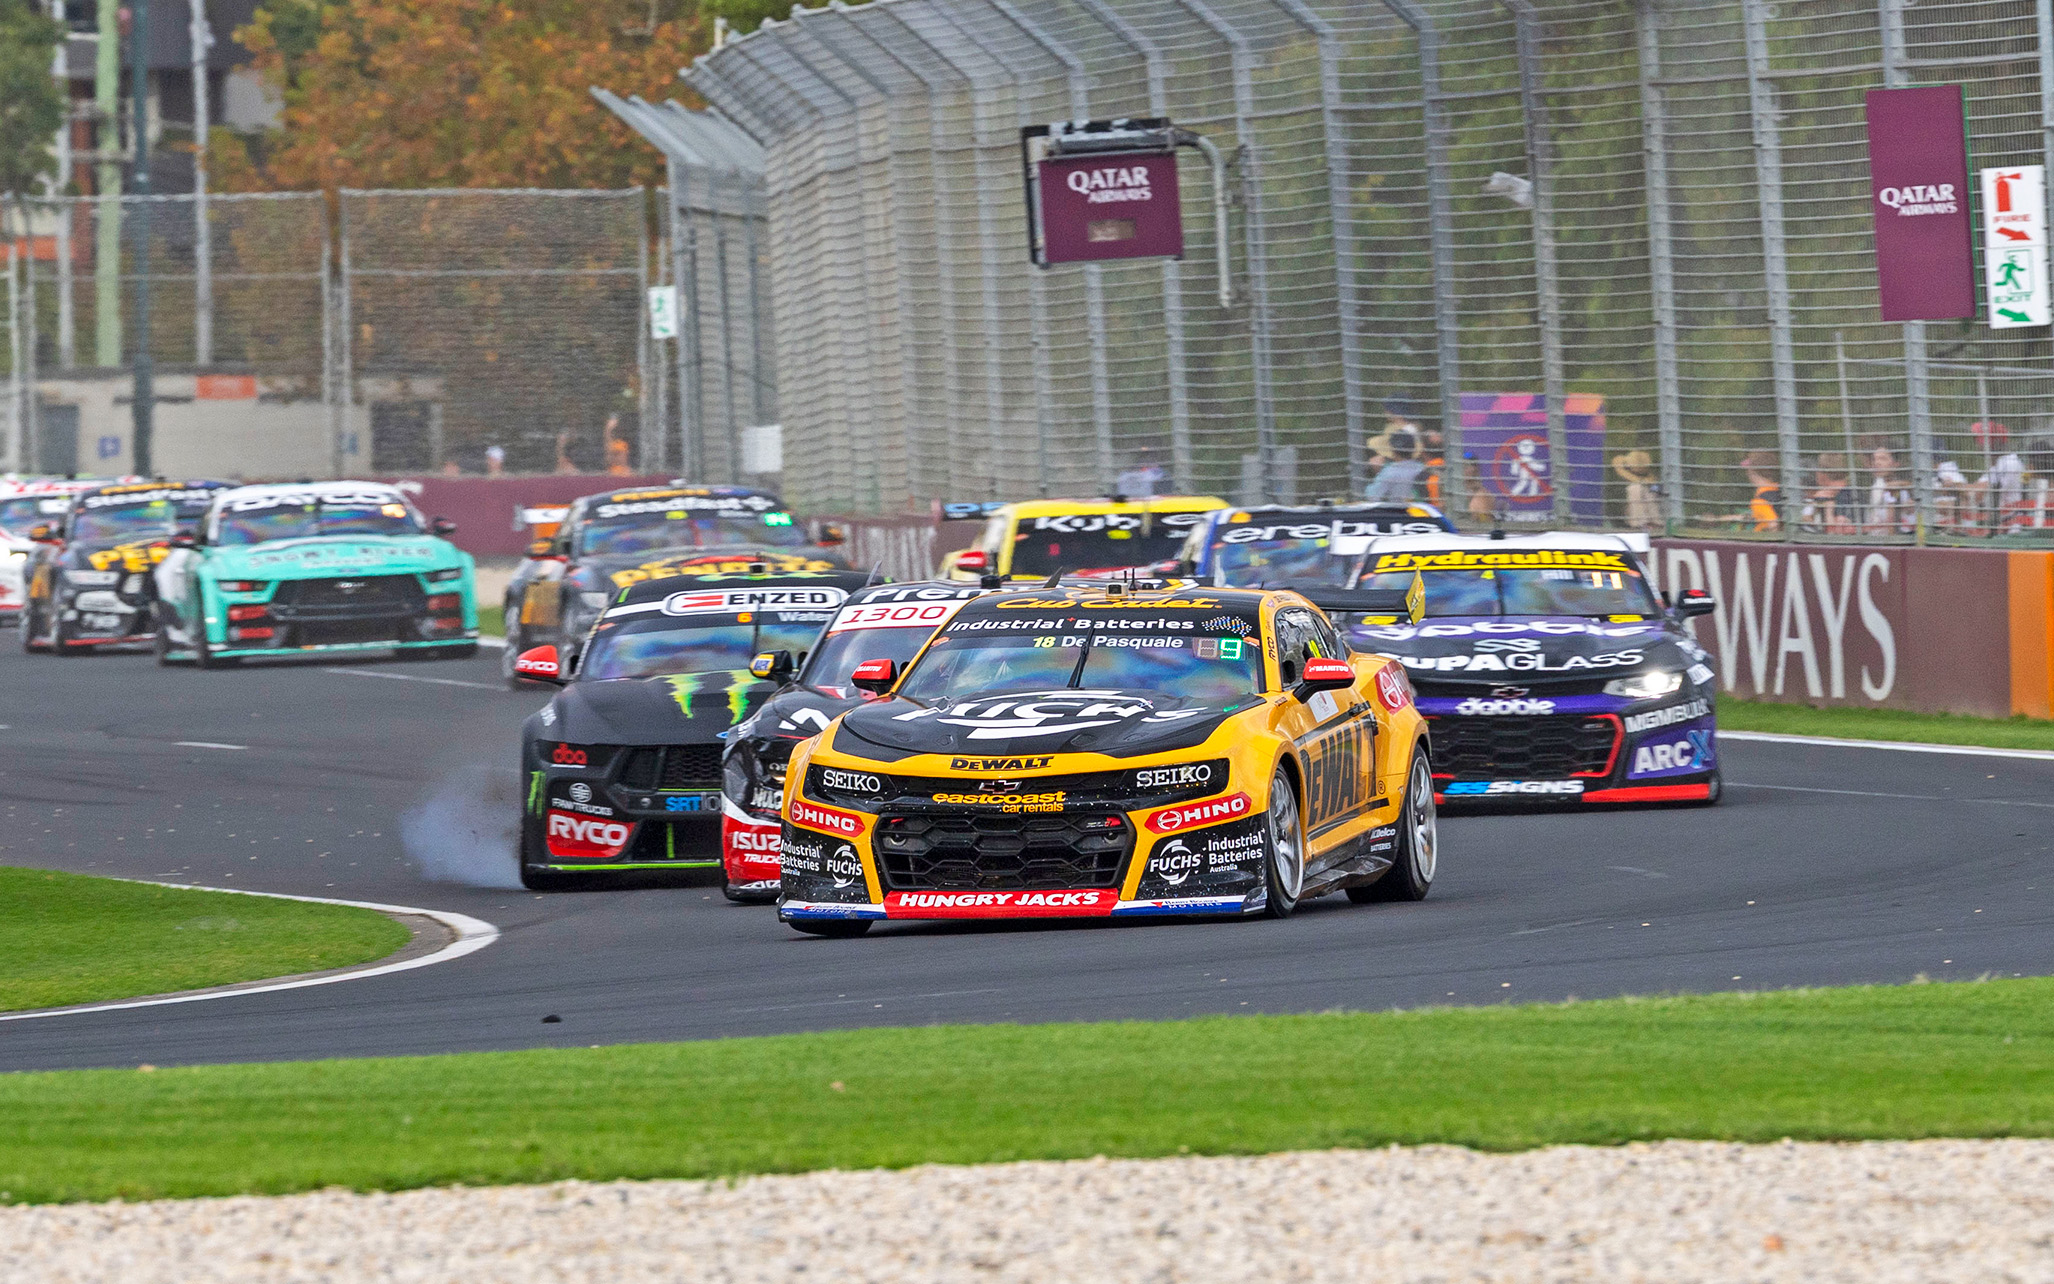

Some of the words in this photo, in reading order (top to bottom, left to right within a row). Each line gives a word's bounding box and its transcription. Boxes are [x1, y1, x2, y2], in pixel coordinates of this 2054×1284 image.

[1067, 166, 1150, 194] QATAR
[1880, 183, 1956, 208] QATAR
[1375, 550, 1628, 569] Hydraulink
[728, 592, 828, 605] ENZED
[997, 597, 1076, 609] Cub
[1081, 596, 1219, 610] Cadet
[737, 612, 752, 623] 6
[842, 606, 947, 624] 1300
[1649, 548, 1897, 700] RWAYS
[946, 618, 1063, 632] Industrial
[1074, 618, 1194, 630] Batteries
[1033, 636, 1056, 648] 18
[1061, 636, 1084, 648] De
[1093, 636, 1184, 649] Pasquale
[1267, 636, 1276, 661] RYCO
[823, 769, 881, 793] SEIKO
[1136, 764, 1211, 788] SEIKO
[932, 790, 1066, 804] eastcoast
[1002, 804, 1023, 813] car
[1024, 802, 1064, 813] rentals
[1184, 797, 1245, 823] HINO
[804, 808, 856, 832] HINO
[549, 814, 629, 847] RYCO
[732, 831, 782, 852] ISUZ
[780, 837, 821, 859] Industrial
[1208, 831, 1264, 852] Industrial
[780, 853, 820, 872] Batteries
[1150, 853, 1201, 873] FUCHS
[1208, 847, 1263, 866] Batteries
[826, 859, 863, 876] FUCHS
[1209, 863, 1238, 873] Australia
[899, 893, 1013, 907] HUNGRY
[1014, 892, 1101, 906] JACK'S
